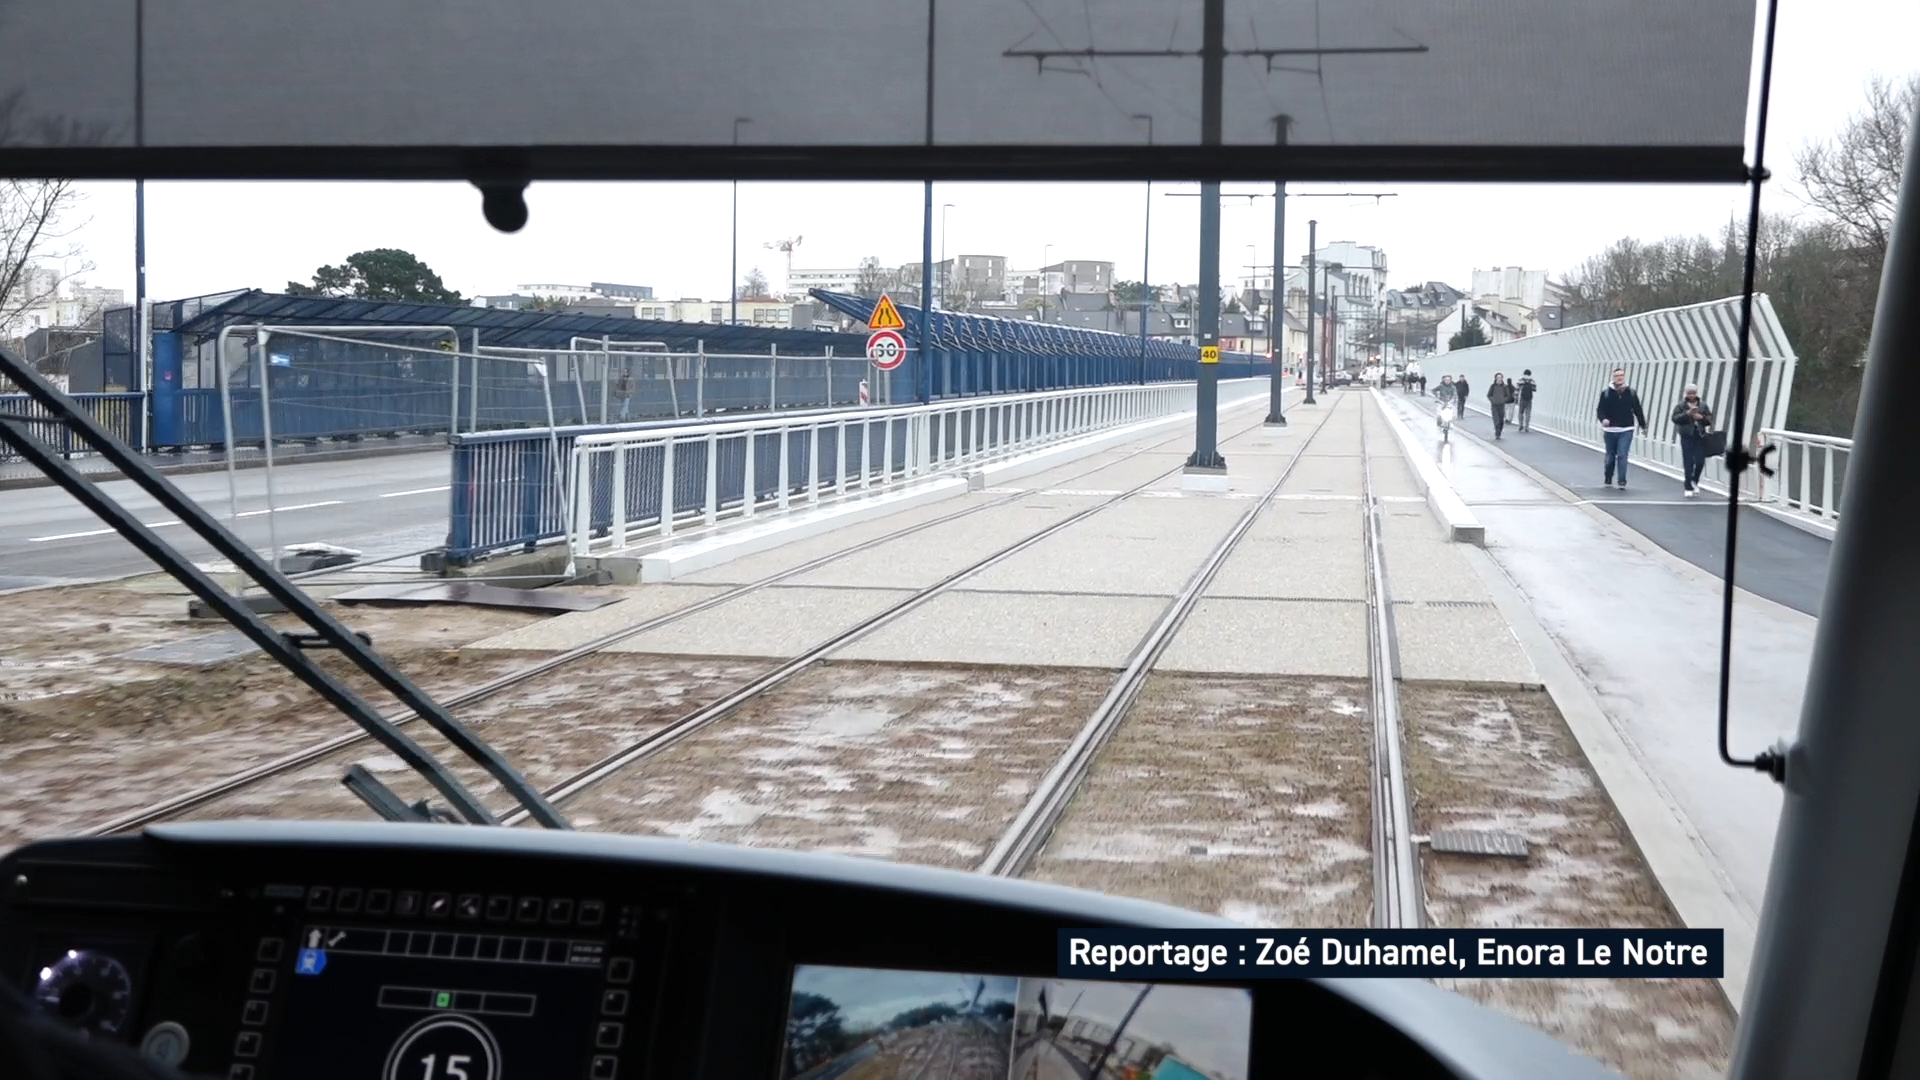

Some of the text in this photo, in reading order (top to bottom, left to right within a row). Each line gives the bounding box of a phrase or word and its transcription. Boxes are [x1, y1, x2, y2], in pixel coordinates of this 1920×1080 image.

[876, 343, 896, 357] 30
[1203, 350, 1216, 359] 40
[420, 1053, 473, 1080] 15
